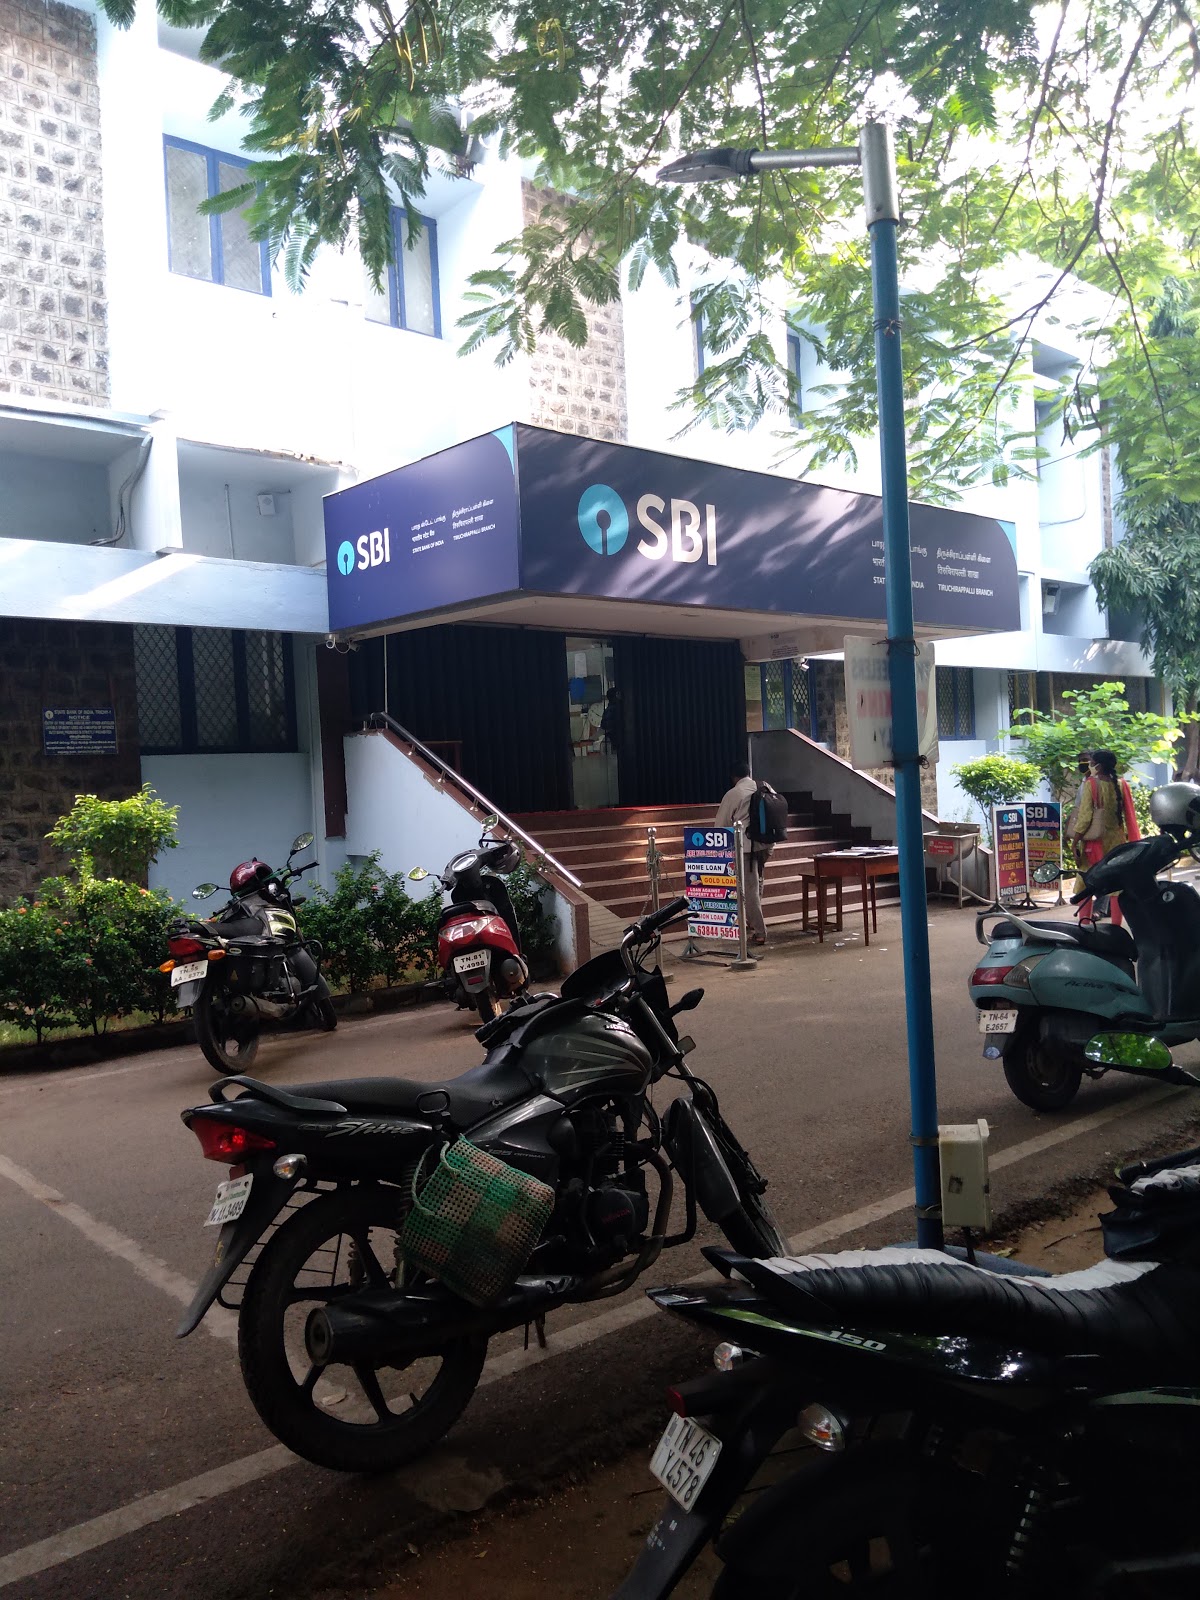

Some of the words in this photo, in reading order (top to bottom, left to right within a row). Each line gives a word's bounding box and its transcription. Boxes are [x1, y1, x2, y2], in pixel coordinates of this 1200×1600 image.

[480, 524, 496, 532] BRANCH
[636, 493, 717, 566] SBI
[357, 528, 390, 570] SBI
[873, 576, 886, 584] STAT
[912, 580, 924, 588] NDIA
[938, 584, 975, 594] TIRUCHIRAPPALLI
[976, 588, 994, 596] BRANCH
[1008, 812, 1018, 823] SBI
[1026, 806, 1048, 819] SBI
[705, 832, 728, 847] SBI
[697, 926, 719, 937] 63844
[461, 954, 482, 963] TN.81
[324, 1122, 417, 1138] Shine
[830, 1330, 887, 1350] 150
[674, 1420, 696, 1453] TN
[661, 1449, 700, 1503] Y4578
